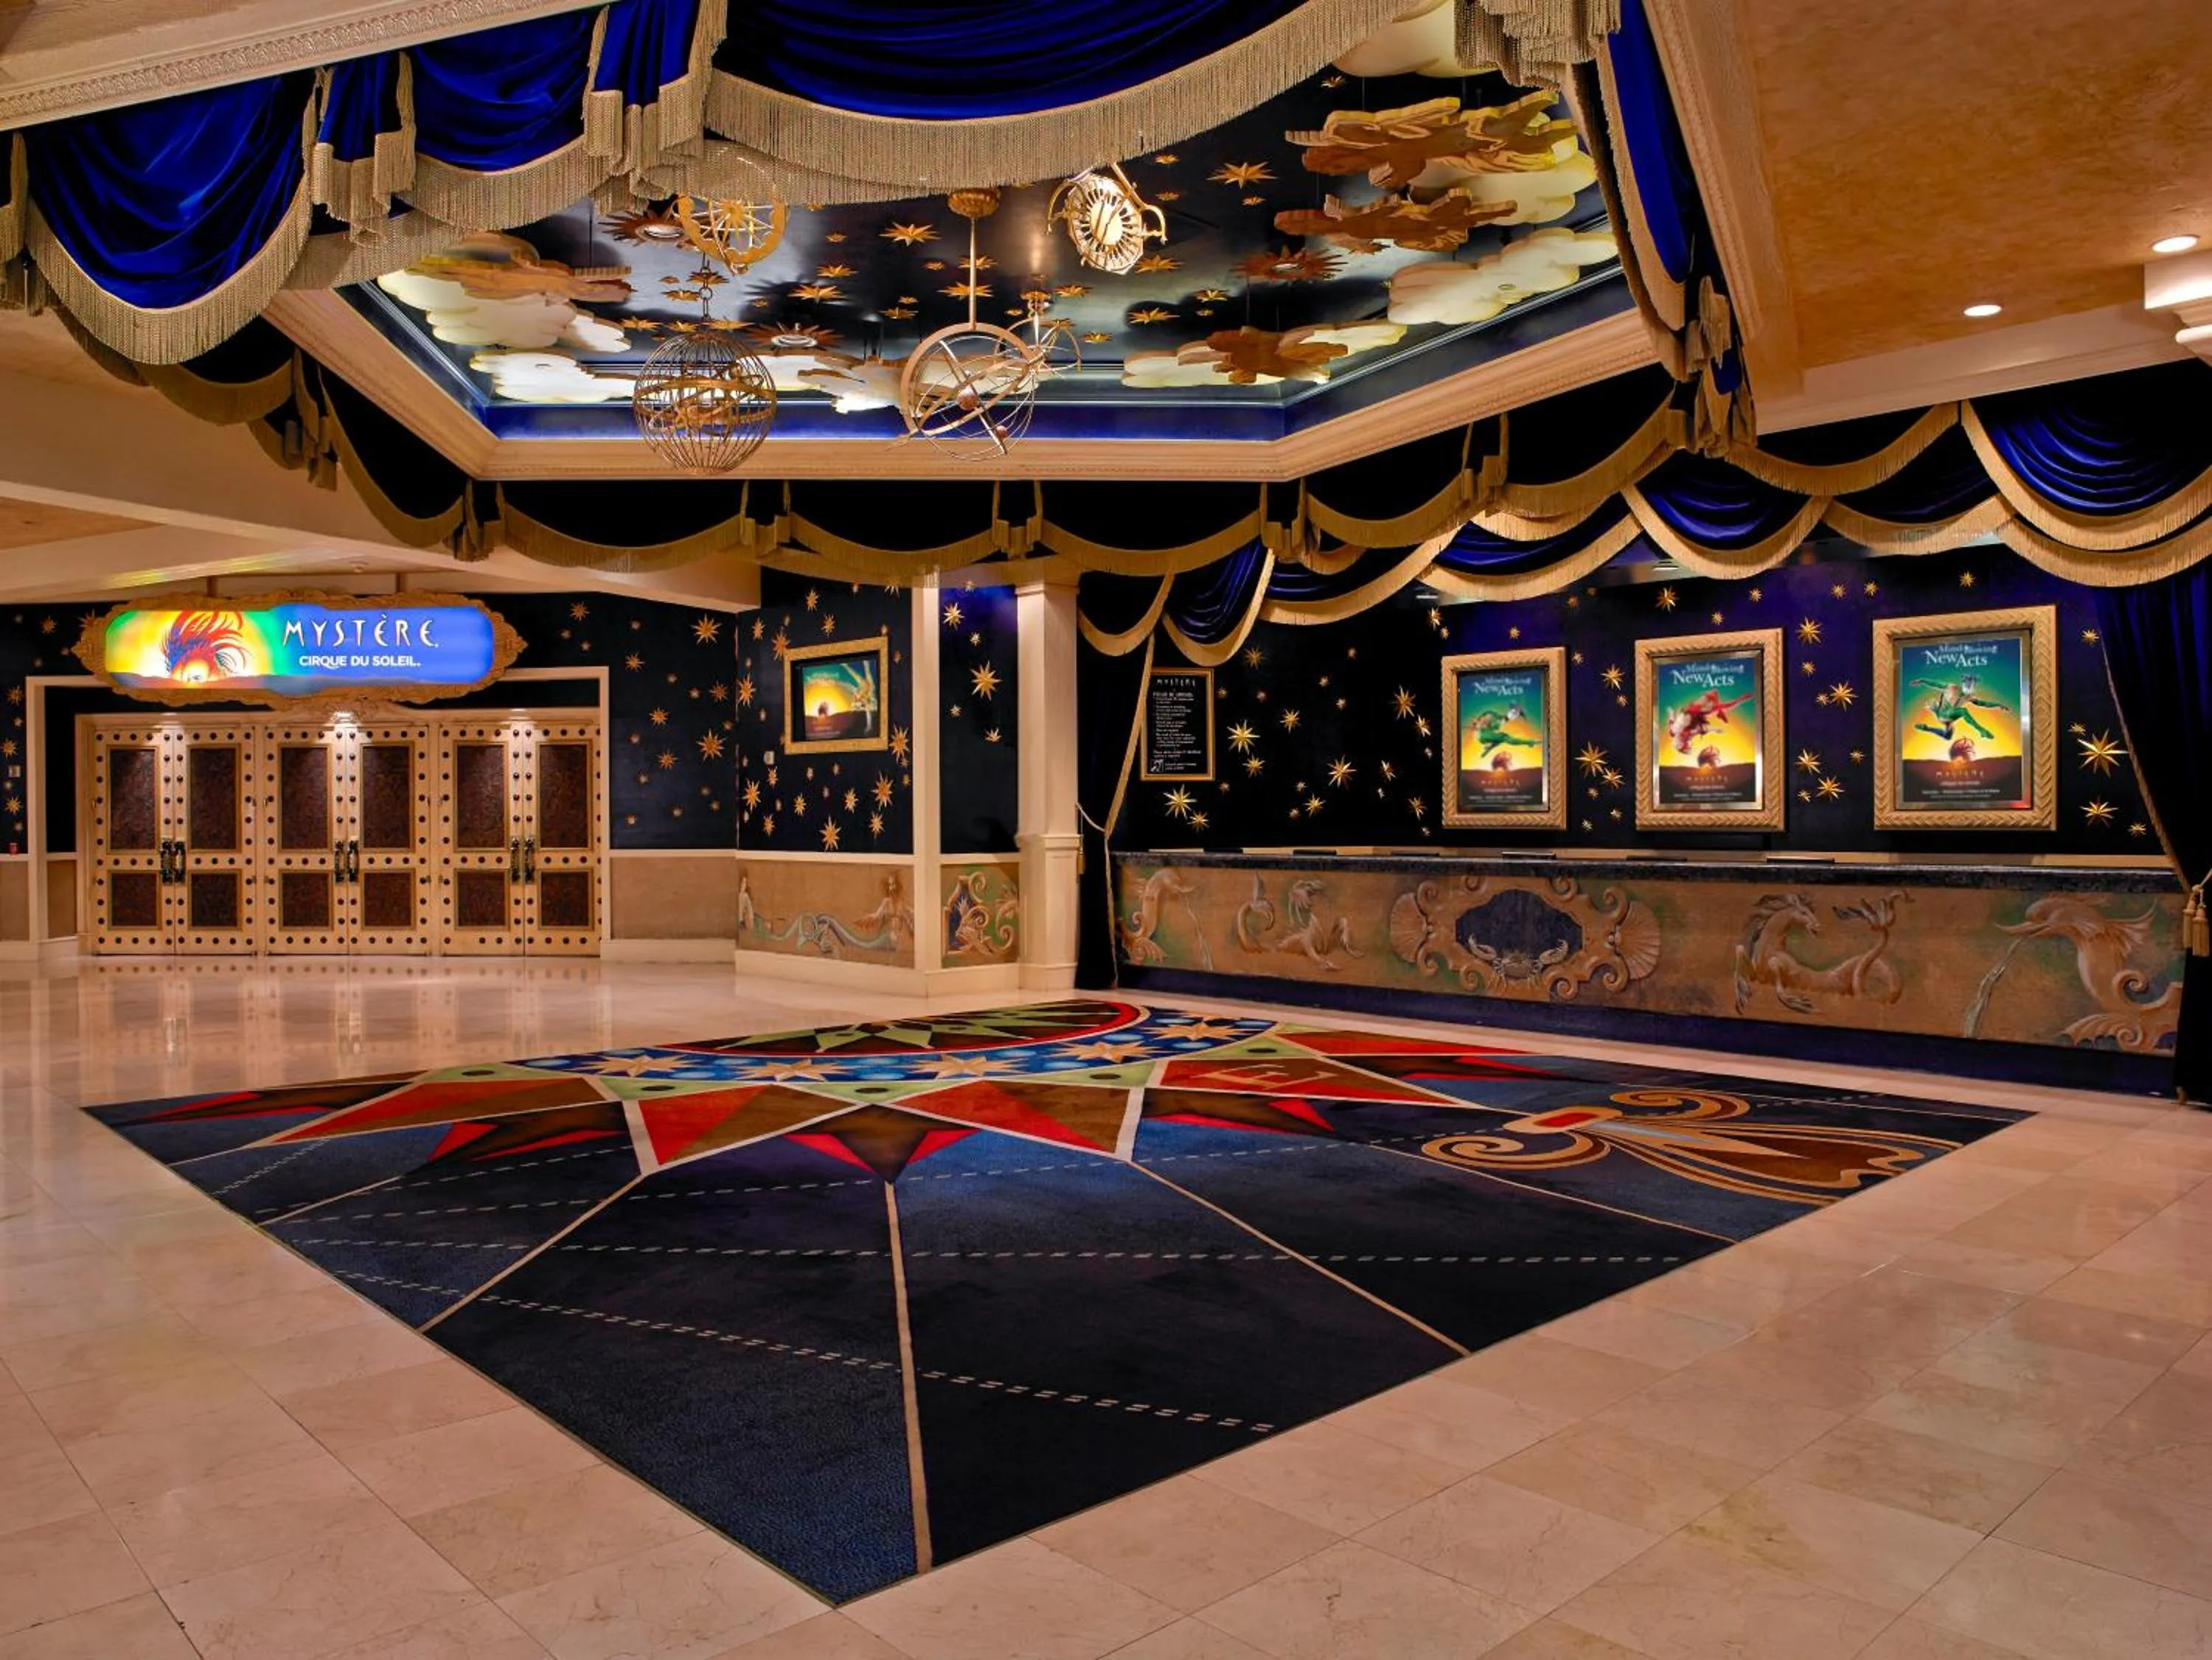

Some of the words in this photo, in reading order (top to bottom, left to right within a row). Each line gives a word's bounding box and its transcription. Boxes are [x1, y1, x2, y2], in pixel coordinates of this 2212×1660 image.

[299, 655, 347, 669] CIRQUE
[350, 655, 369, 667] DU
[1955, 653, 1988, 668] Acts
[1702, 672, 1736, 688] Acts
